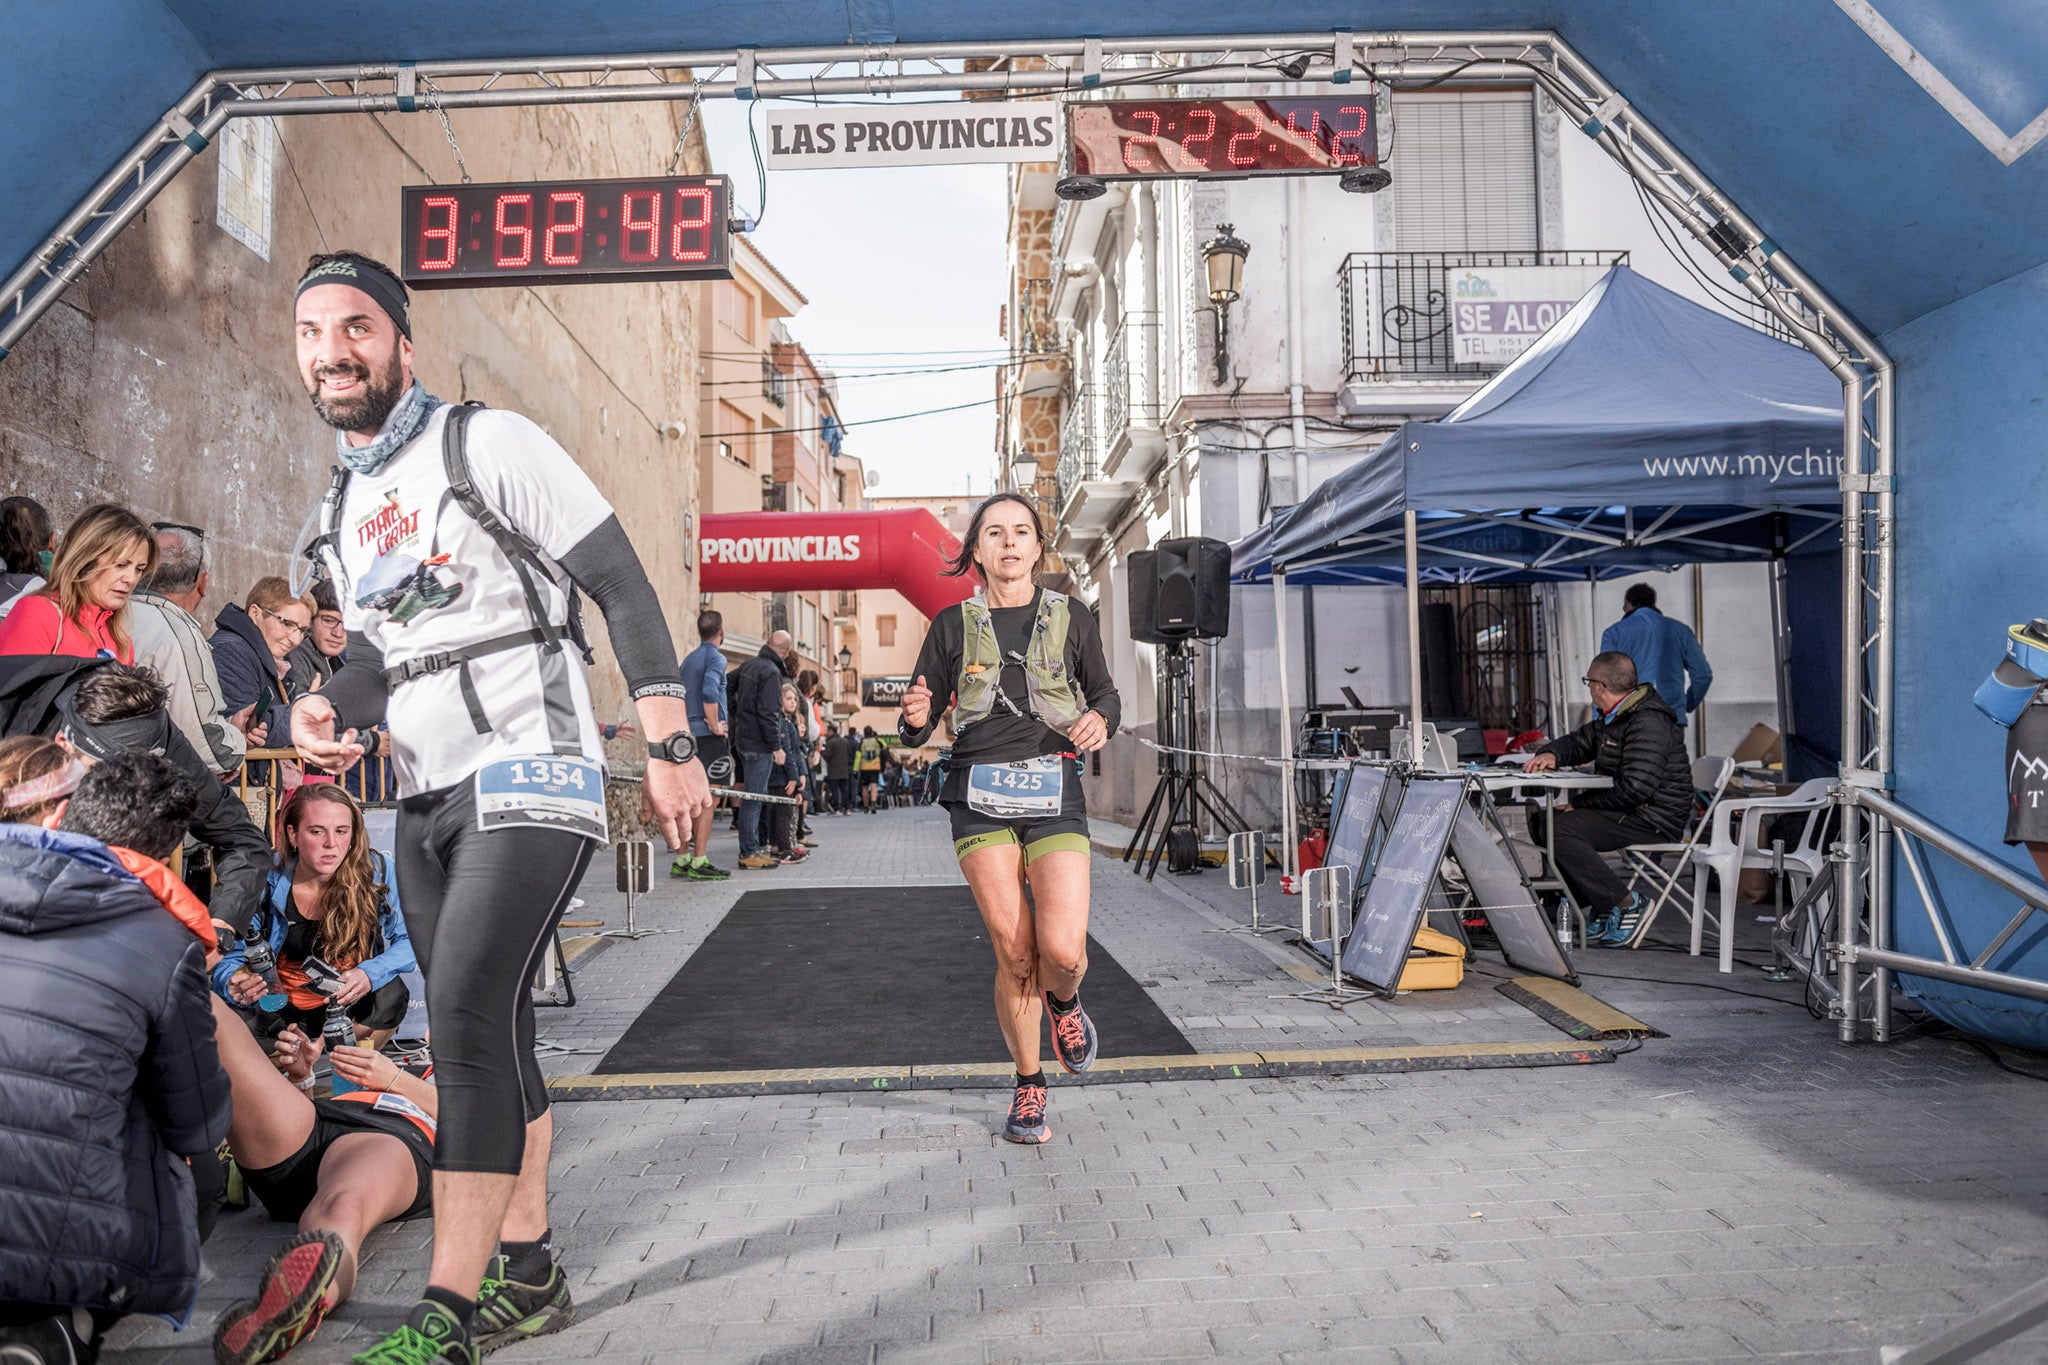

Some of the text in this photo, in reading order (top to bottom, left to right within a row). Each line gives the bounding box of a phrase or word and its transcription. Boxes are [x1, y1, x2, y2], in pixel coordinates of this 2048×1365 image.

[771, 116, 1053, 155] LAS PROVINCIAS
[1460, 303, 1492, 332] SE
[701, 535, 861, 564] PROVINCIAS
[510, 761, 586, 790] 1354
[991, 770, 1043, 790] 1425
